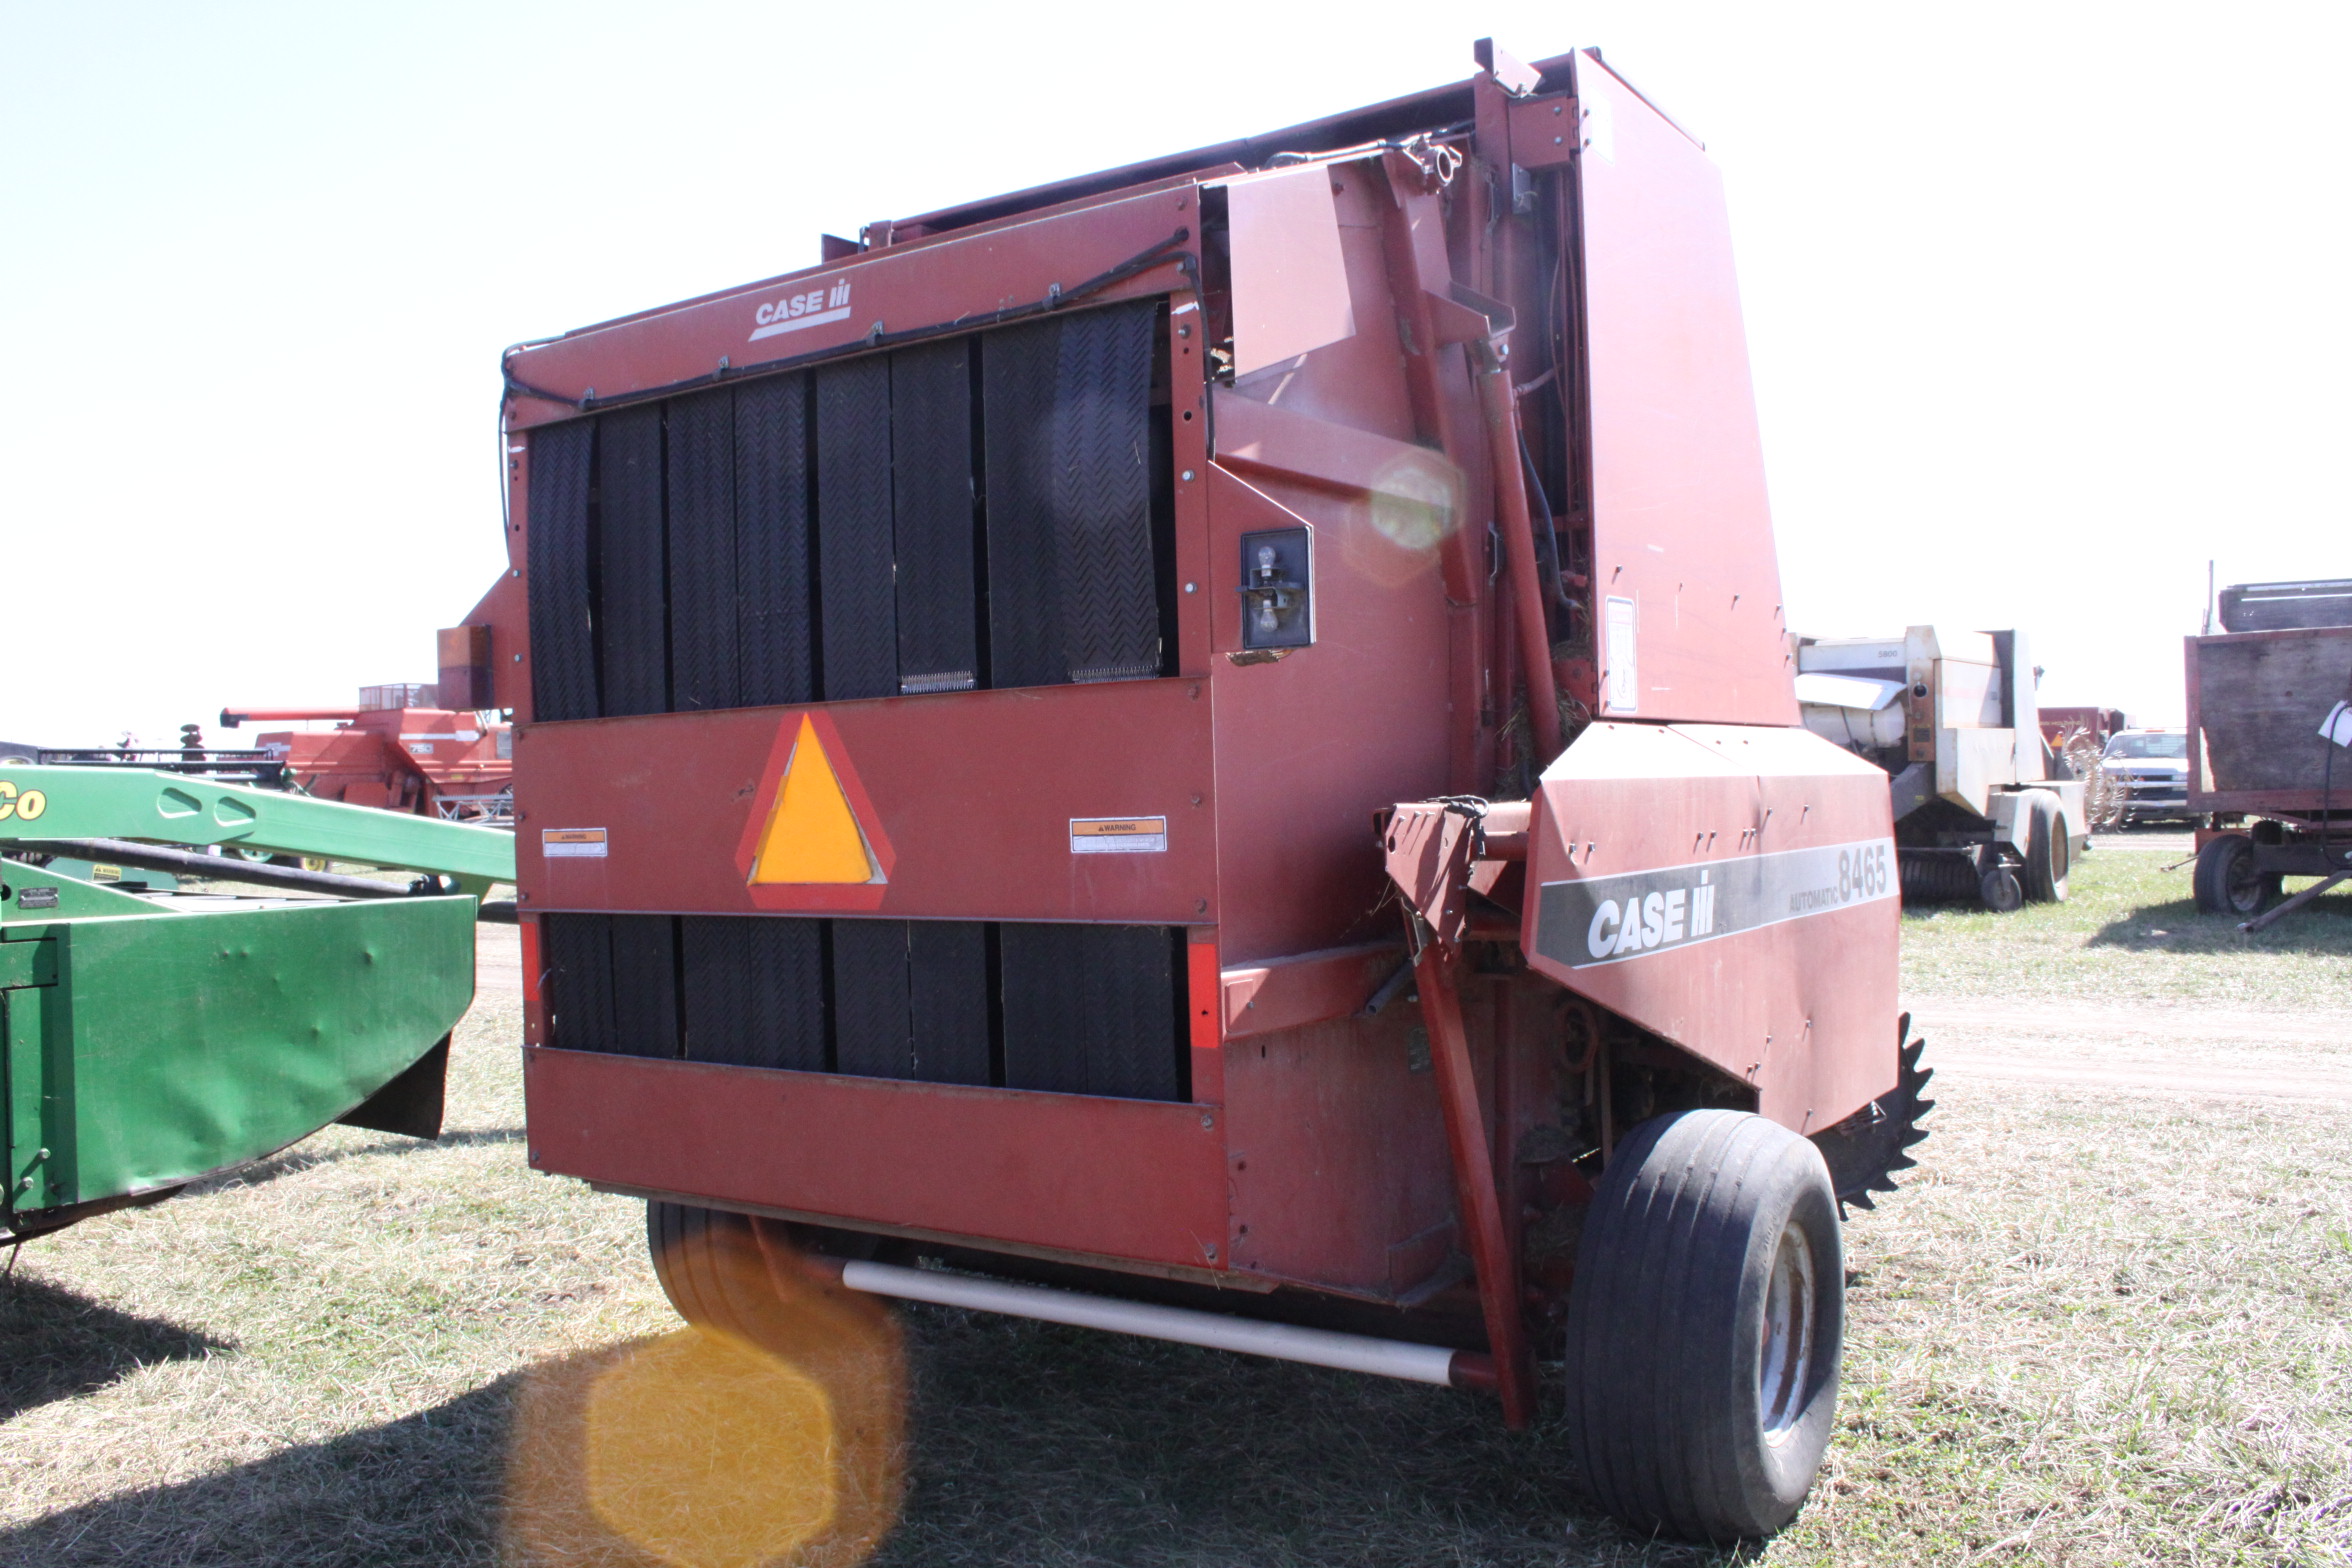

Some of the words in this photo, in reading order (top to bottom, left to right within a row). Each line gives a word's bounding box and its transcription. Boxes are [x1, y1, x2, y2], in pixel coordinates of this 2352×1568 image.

[756, 290, 824, 325] CASE
[1878, 650, 1898, 658] 5800
[1104, 824, 1136, 832] WARNING
[1789, 886, 1839, 912] AUTOMATIC
[1839, 844, 1887, 903] 8465
[1588, 888, 1686, 958] CASE
